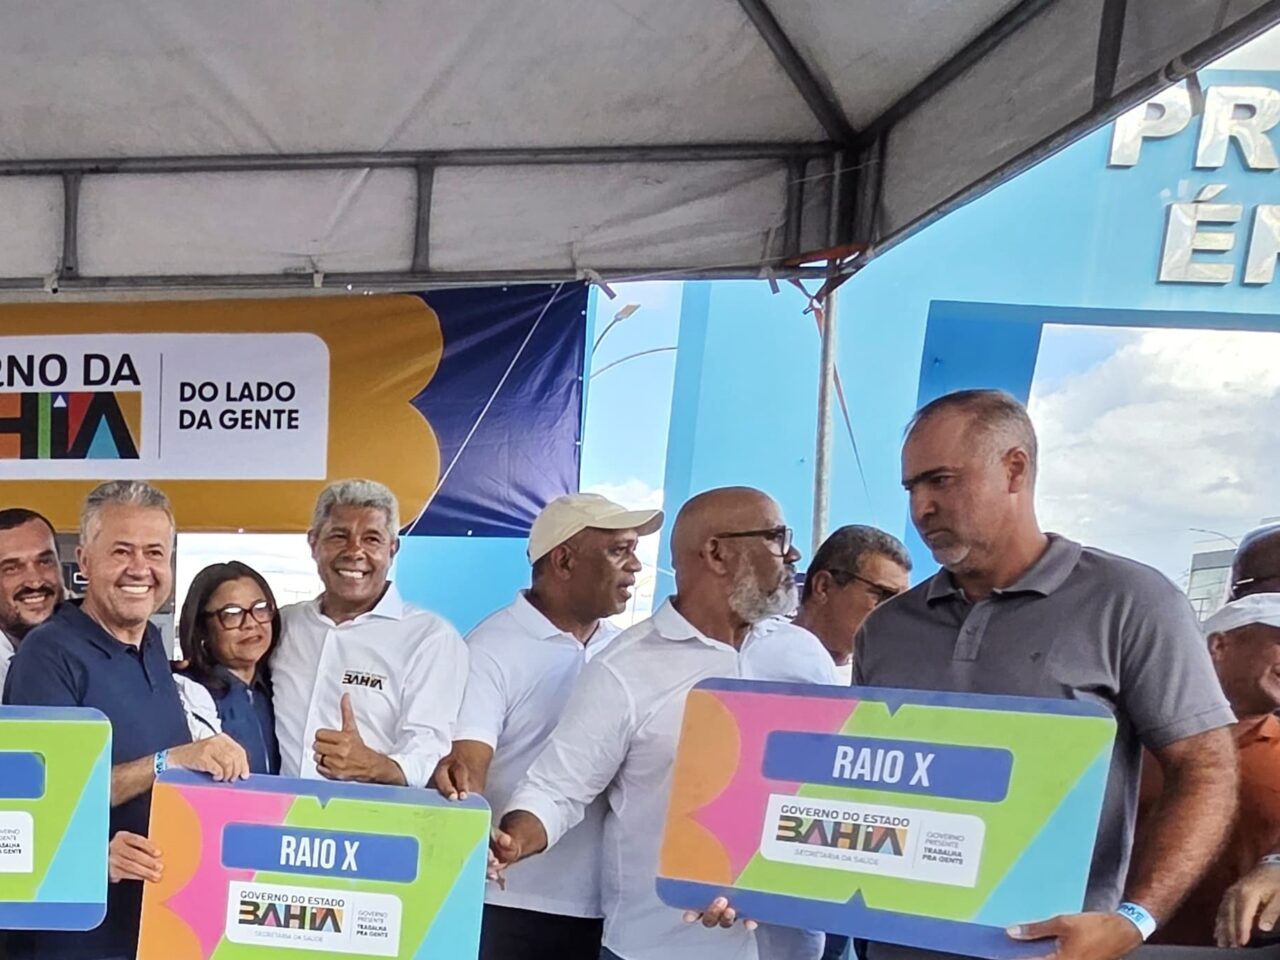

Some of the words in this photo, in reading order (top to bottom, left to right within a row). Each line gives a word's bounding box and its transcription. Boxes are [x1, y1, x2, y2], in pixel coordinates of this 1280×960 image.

[82, 353, 141, 386] DA
[179, 382, 219, 402] DO
[225, 381, 296, 402] LADO
[179, 409, 213, 430] DA
[218, 408, 300, 430] GENTE
[832, 746, 904, 783] RAIO
[909, 751, 935, 787] X
[781, 804, 839, 820] GOVERNO
[843, 811, 860, 822] DO
[863, 814, 910, 827] ESTADO
[775, 815, 908, 857] BAHIA
[280, 836, 336, 870] RAIO
[342, 841, 360, 871] X
[240, 890, 288, 903] GOVERNO
[291, 895, 305, 904] DO
[308, 897, 344, 908] ESTADO
[238, 900, 343, 933] BAHIA
